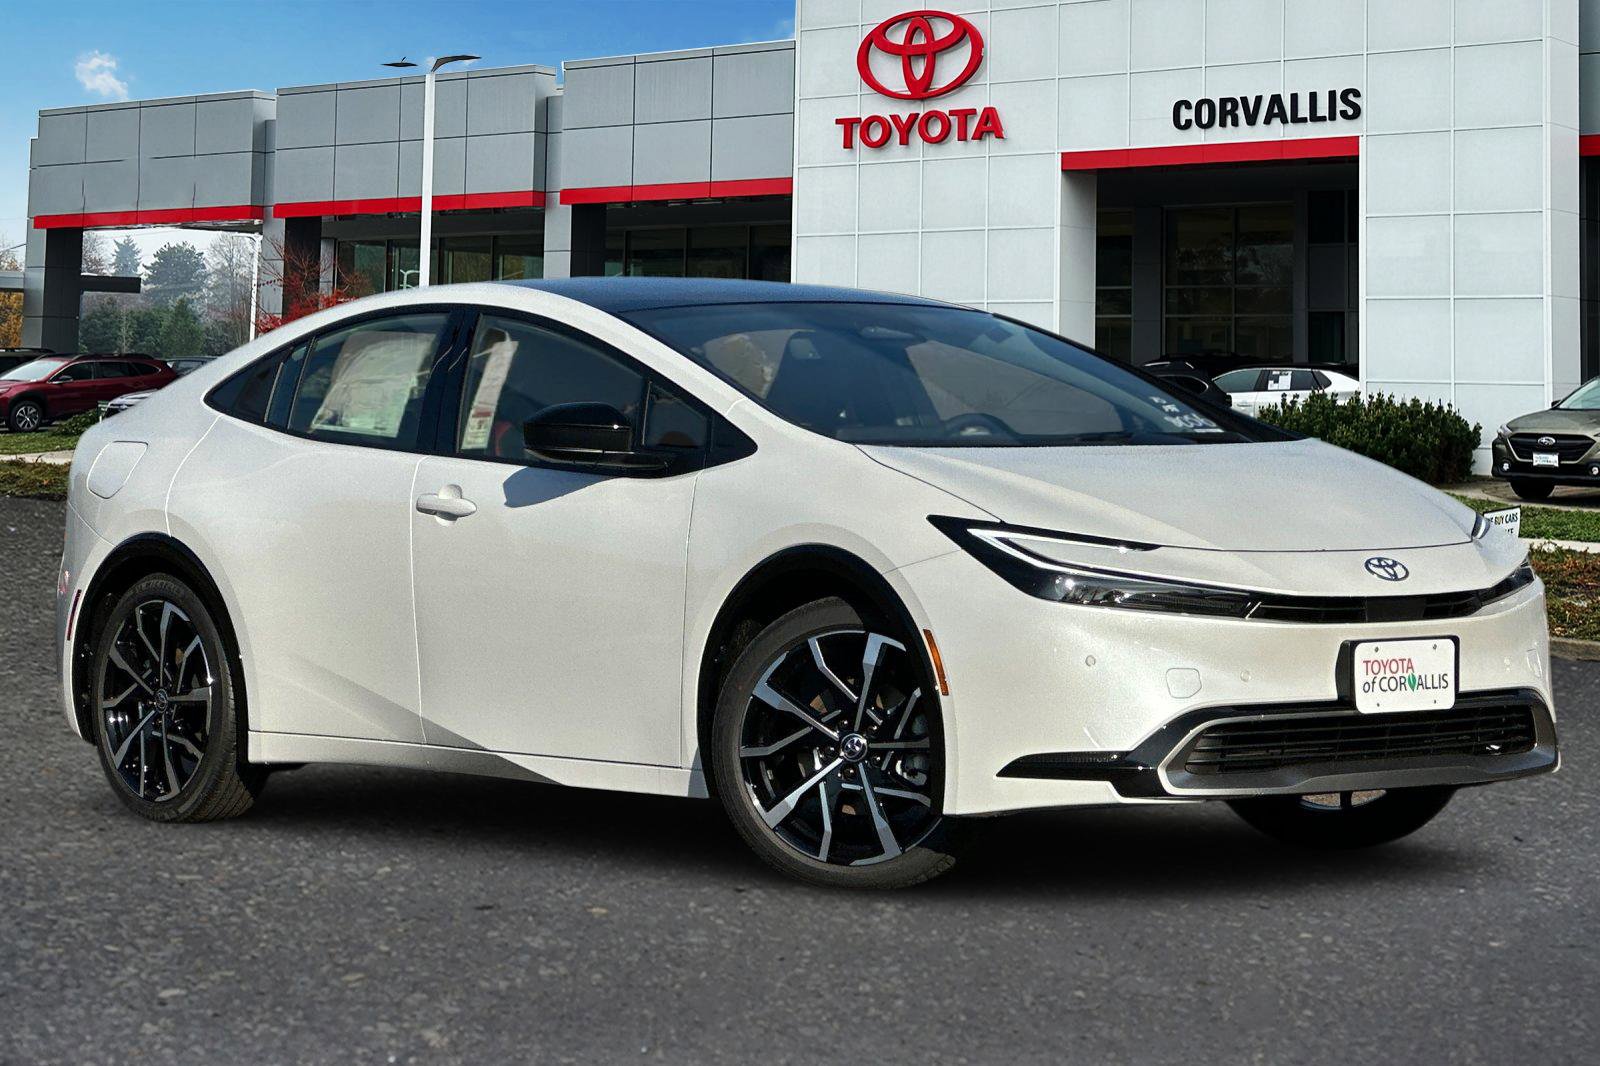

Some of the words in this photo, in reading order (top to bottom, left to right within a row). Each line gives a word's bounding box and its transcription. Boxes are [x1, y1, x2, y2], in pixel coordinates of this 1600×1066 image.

[1172, 88, 1362, 130] CORVALLIS
[835, 106, 1005, 149] TOYOTA
[1362, 658, 1415, 675] TOYOTA
[1362, 676, 1377, 693] of
